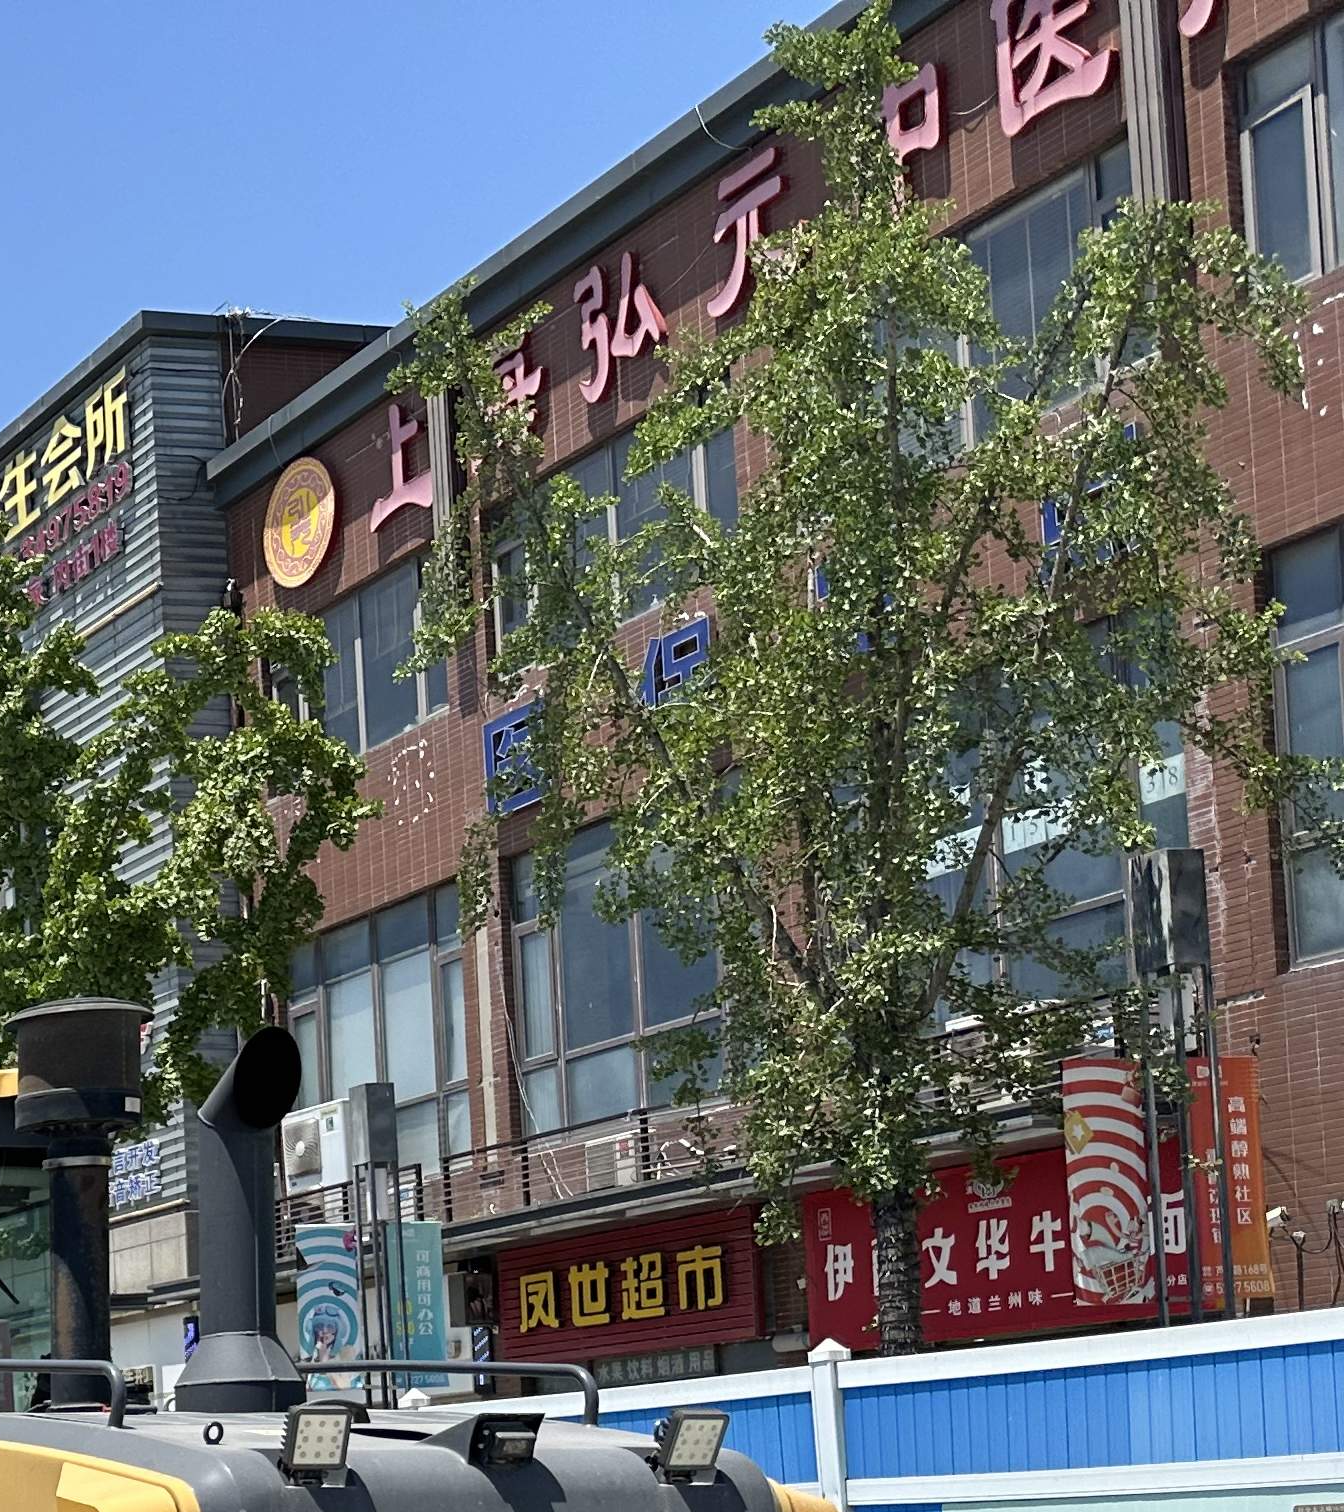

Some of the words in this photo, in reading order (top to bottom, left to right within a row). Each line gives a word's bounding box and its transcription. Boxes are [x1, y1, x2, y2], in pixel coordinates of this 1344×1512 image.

[109, 1170, 162, 1206] 音矫正
[824, 1189, 1186, 1302] 伊文华牛面
[519, 1245, 724, 1333] 凤世超市
[948, 1288, 1044, 1316] 地道兰州味
